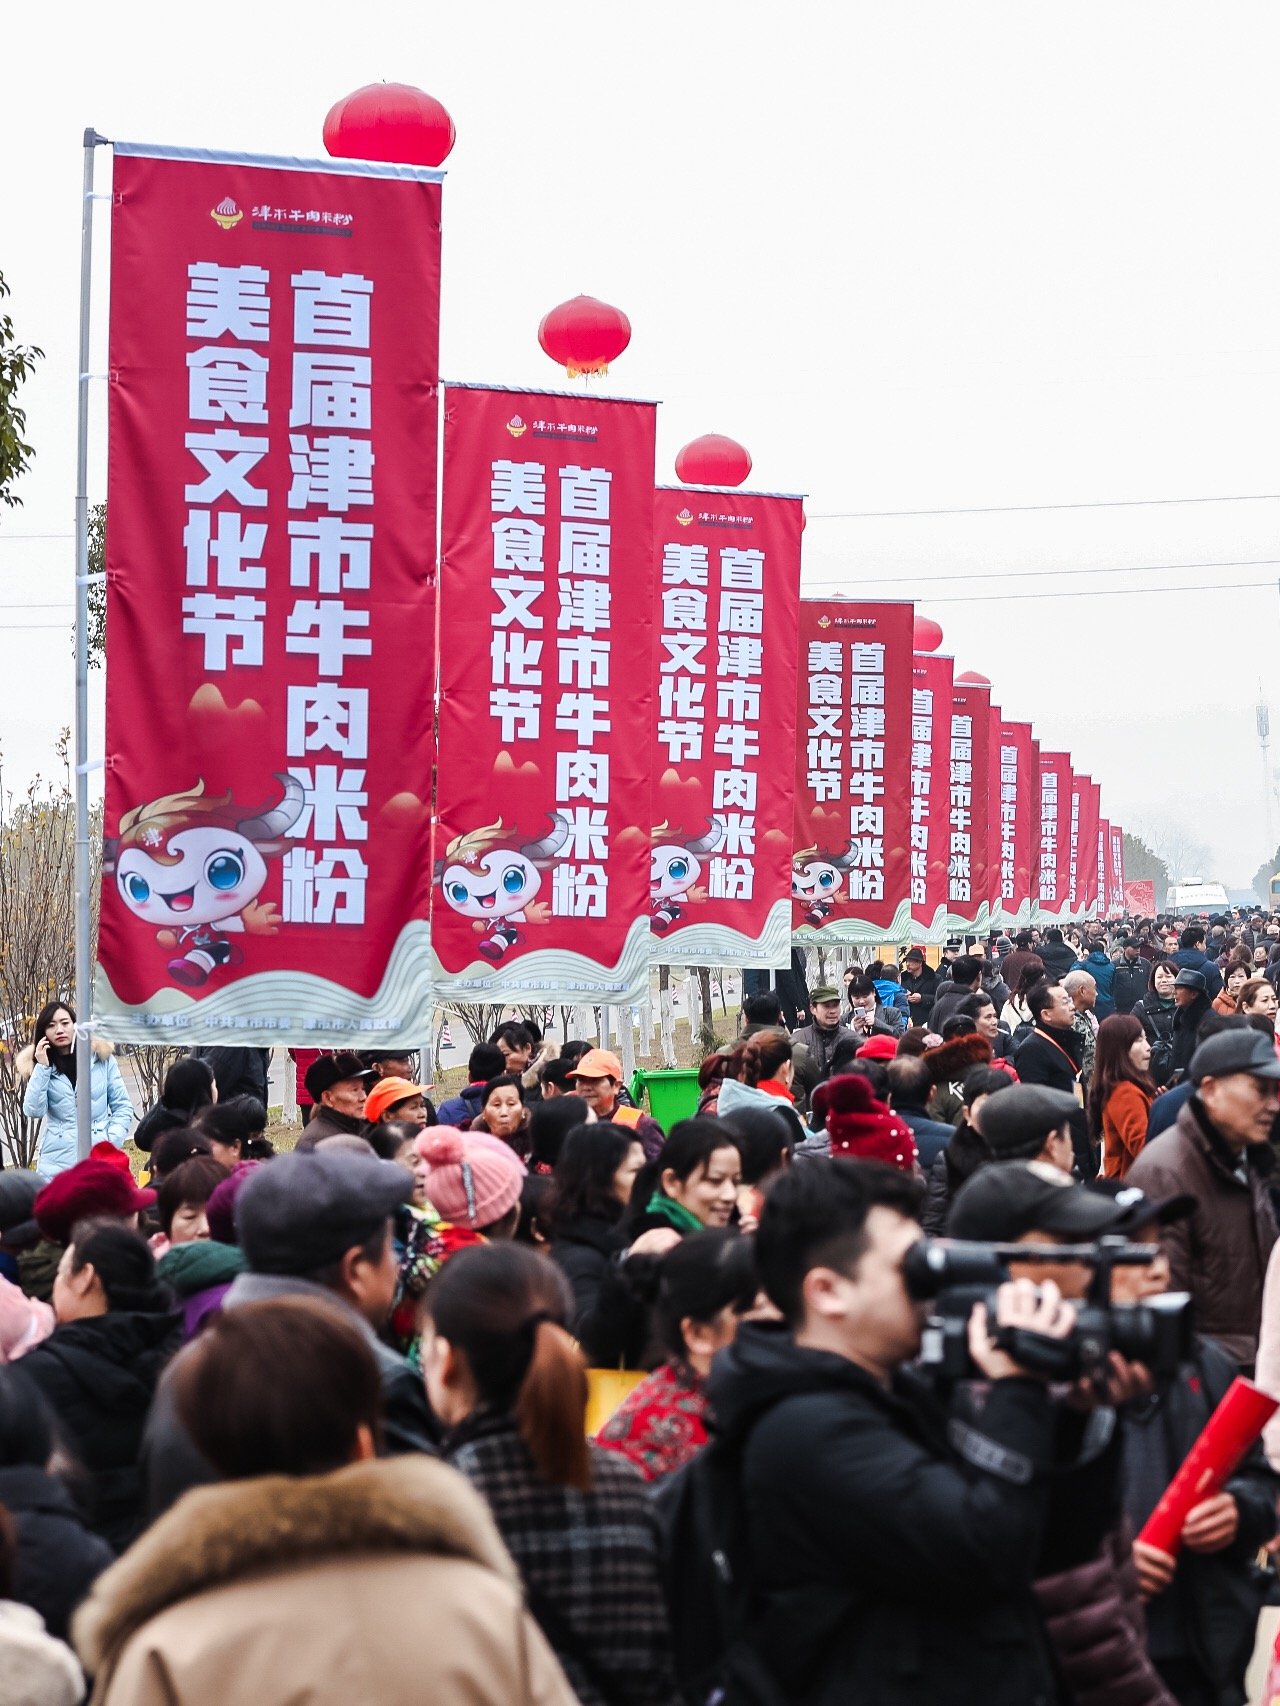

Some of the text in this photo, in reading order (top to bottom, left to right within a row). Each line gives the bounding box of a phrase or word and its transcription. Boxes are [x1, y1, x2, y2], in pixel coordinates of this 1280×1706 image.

[182, 262, 270, 672] 美食文化节
[282, 270, 375, 924] 首届津市牛肉米粉
[489, 459, 546, 744] 美食文化节
[552, 465, 613, 918] 首届津市牛肉米粉
[657, 542, 708, 763] 美食文化节
[708, 547, 765, 900] 首届津市牛肉米粉
[806, 640, 843, 802] 美食文化节
[849, 642, 886, 901] 首届津市牛肉米粉
[949, 715, 973, 902] 首届津市牛肉米粉
